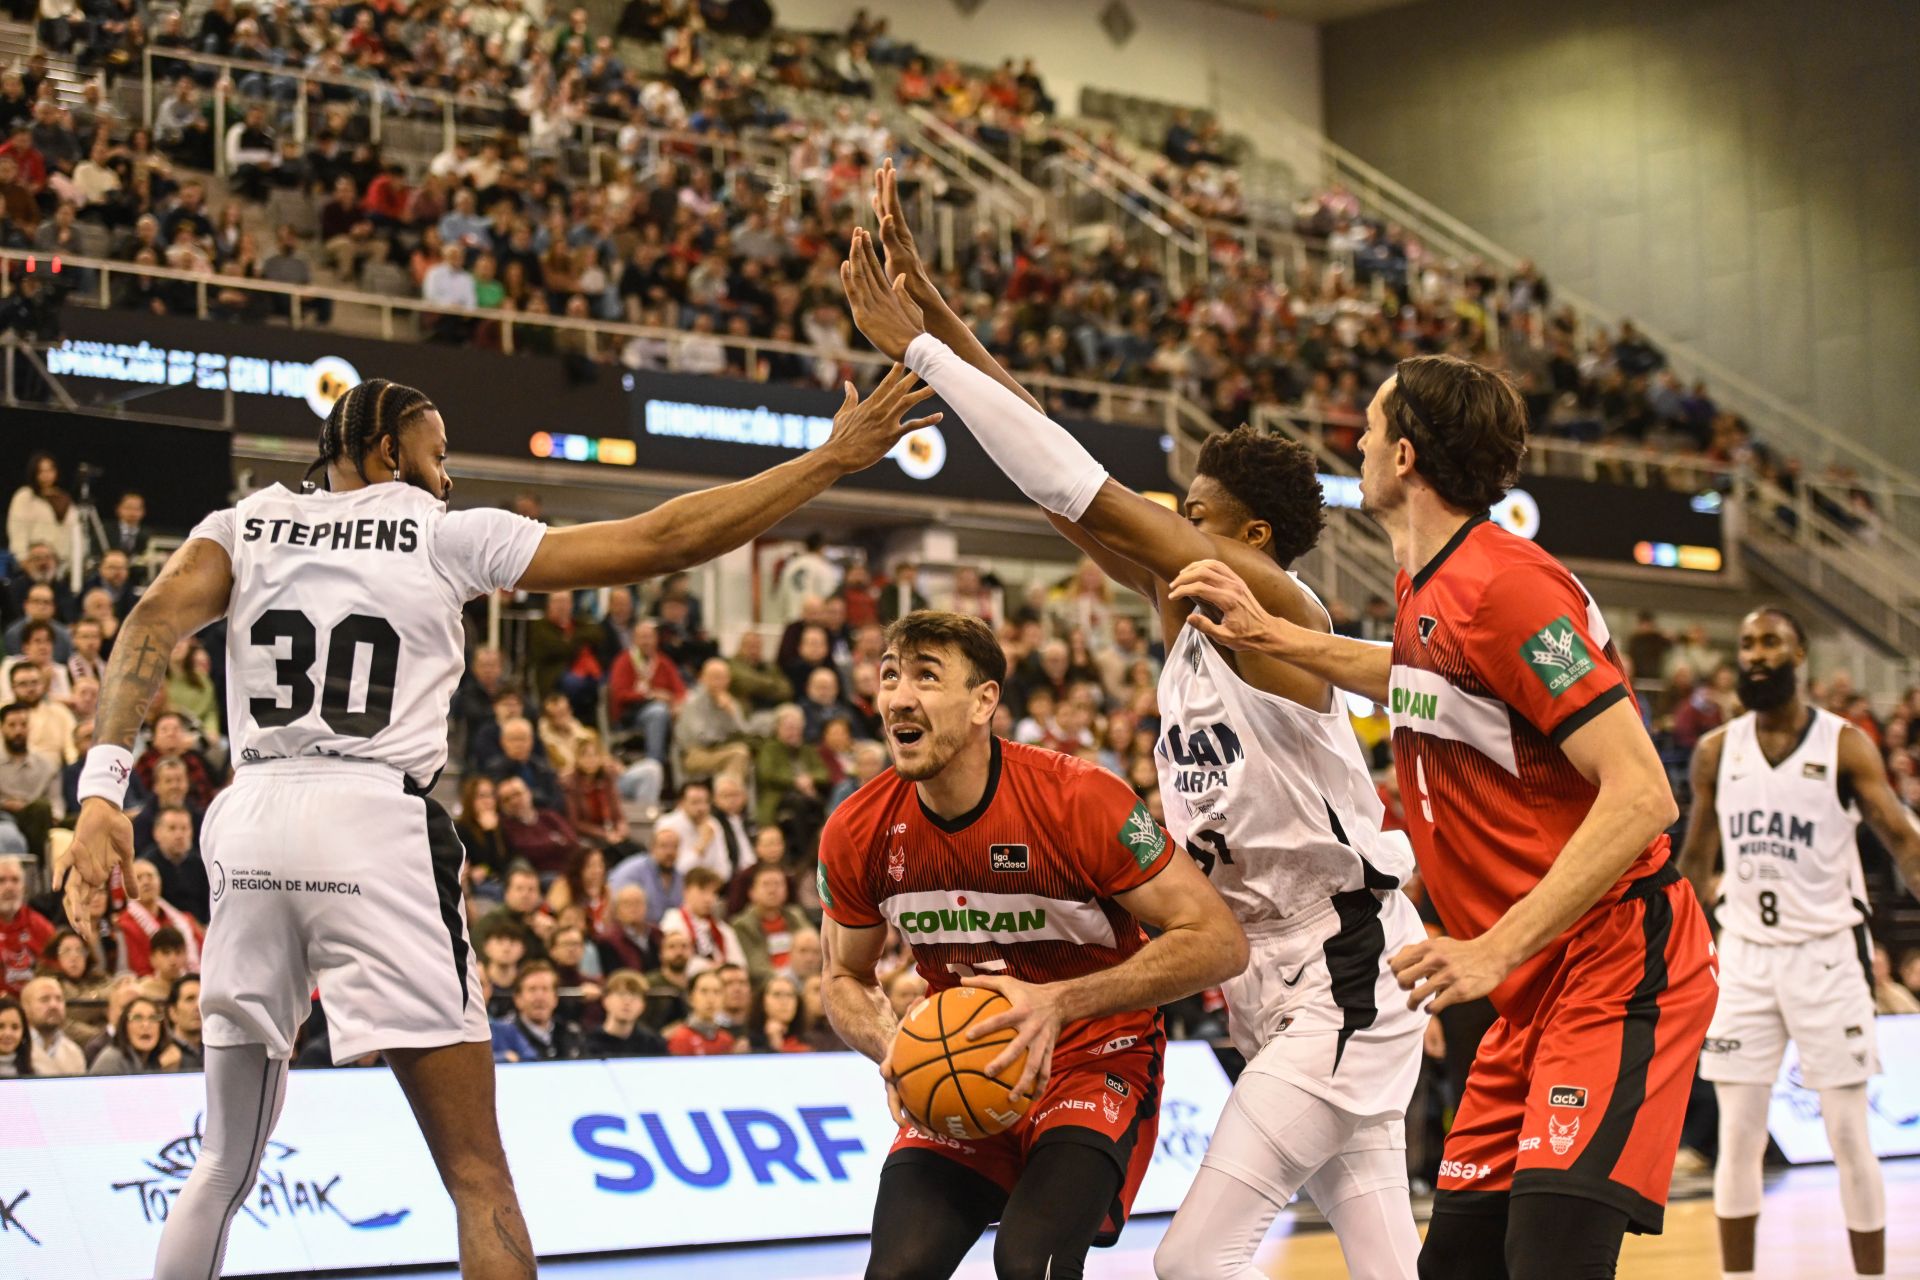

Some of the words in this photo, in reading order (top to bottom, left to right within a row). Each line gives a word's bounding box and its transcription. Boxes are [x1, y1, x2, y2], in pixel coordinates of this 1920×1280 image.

[243, 518, 418, 553] STEPHENS
[250, 609, 400, 739] 30
[1729, 809, 1815, 848] UCAM
[993, 852, 1008, 863] liga
[994, 860, 1026, 868] endesa
[1739, 840, 1798, 863] MURCIA
[232, 877, 282, 890] REGIÓN
[286, 880, 302, 891] DE
[305, 881, 361, 895] MURCIA
[900, 896, 1046, 934] COVIRAN
[1759, 891, 1779, 927] 8
[1107, 1078, 1124, 1093] acb
[1552, 1094, 1578, 1105] acb
[571, 1105, 866, 1194] SURF
